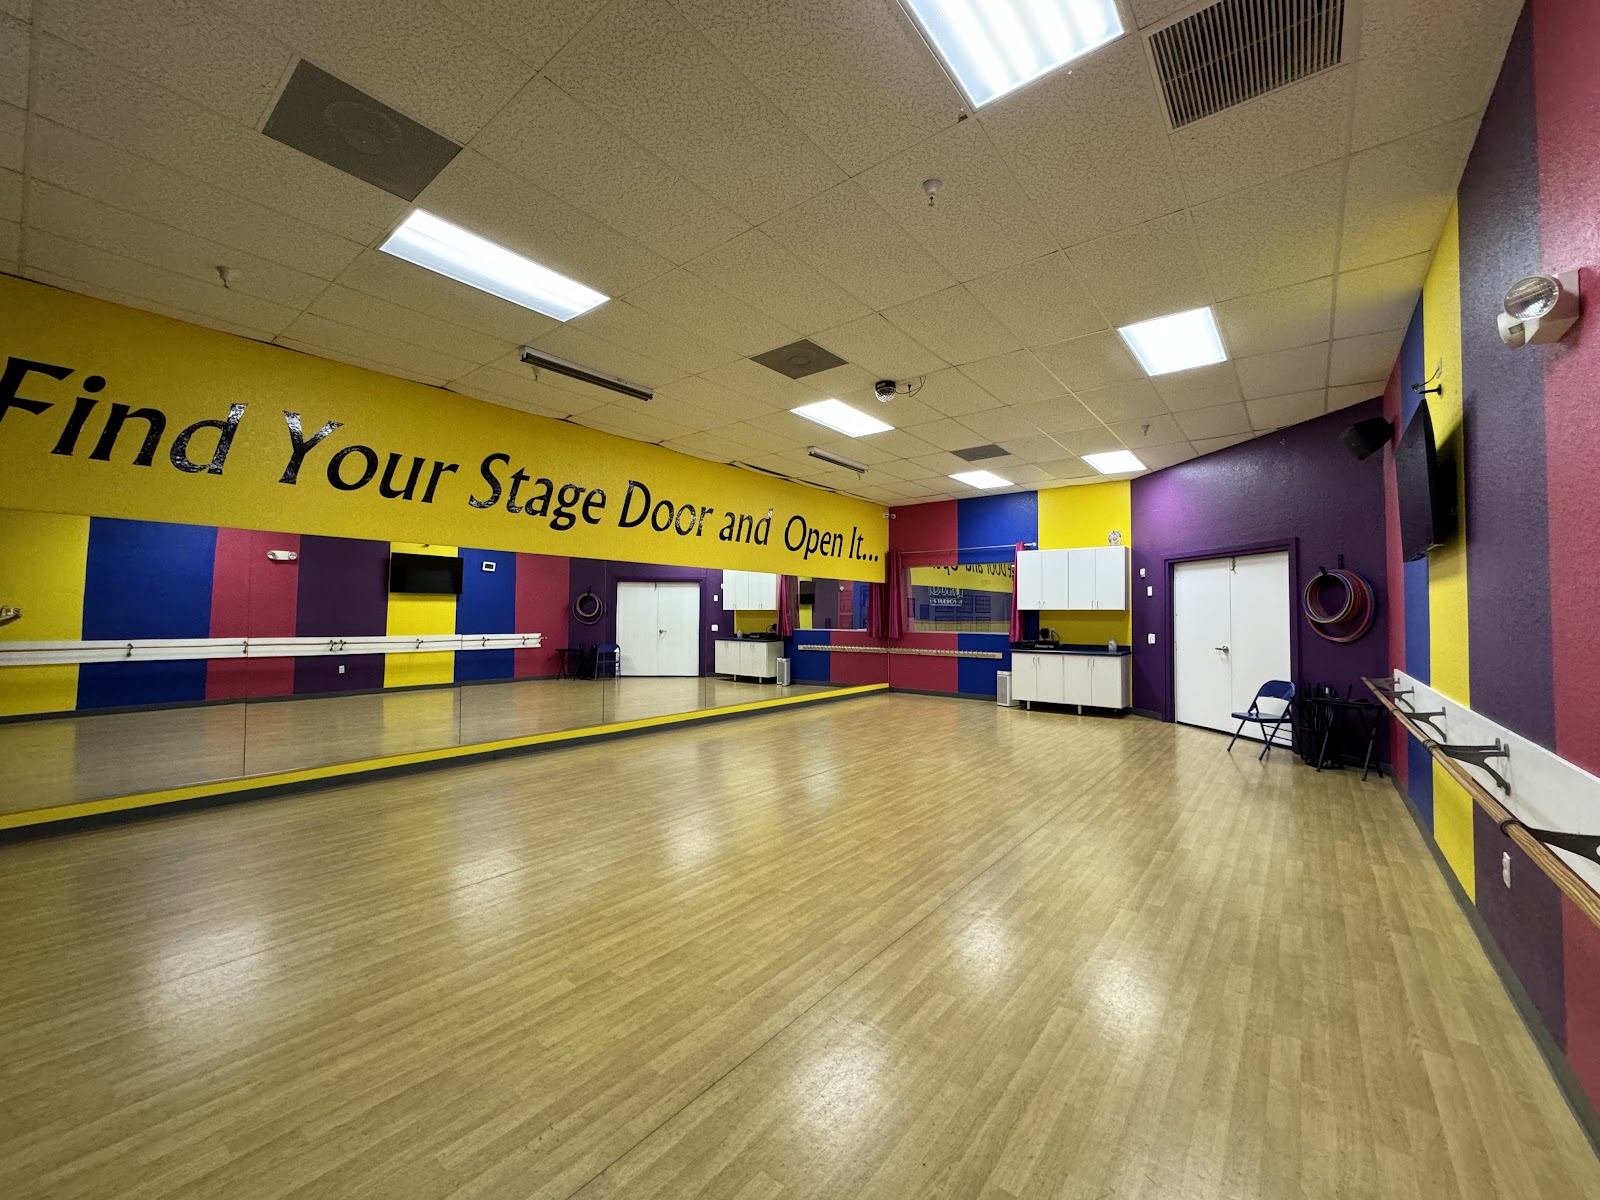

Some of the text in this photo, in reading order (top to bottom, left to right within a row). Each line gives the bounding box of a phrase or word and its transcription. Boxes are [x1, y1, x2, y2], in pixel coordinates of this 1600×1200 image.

[0, 356, 879, 563] Find Your Stage Door and Open It...
